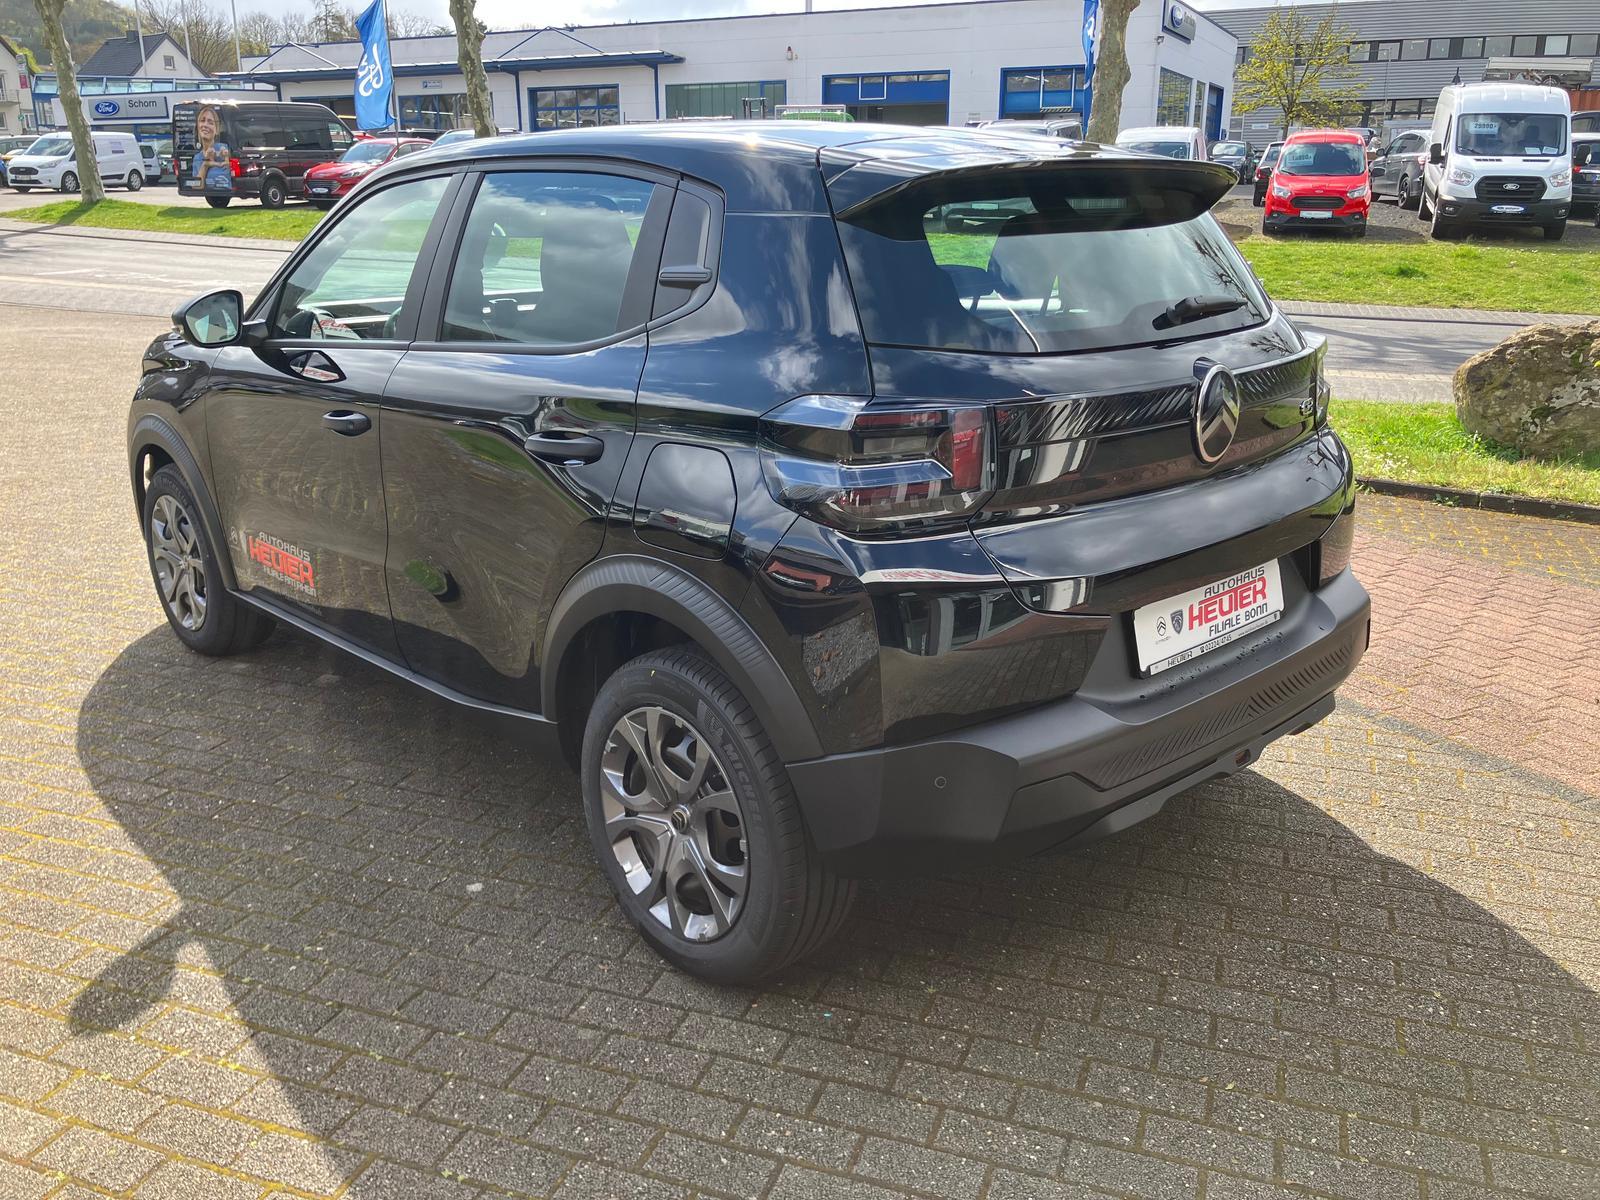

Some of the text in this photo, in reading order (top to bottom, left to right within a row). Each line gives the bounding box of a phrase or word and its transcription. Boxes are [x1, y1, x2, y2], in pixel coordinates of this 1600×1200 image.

[97, 99, 157, 113] Ford Schorn
[248, 535, 315, 589] HEUTER
[259, 532, 311, 562] AUTOHAUS
[1204, 566, 1265, 598] AUTOHAUS
[1188, 576, 1267, 631] HEUTER
[1209, 614, 1241, 637] FILIALE
[1244, 603, 1268, 621] BONN
[1167, 651, 1193, 667] HEUTER
